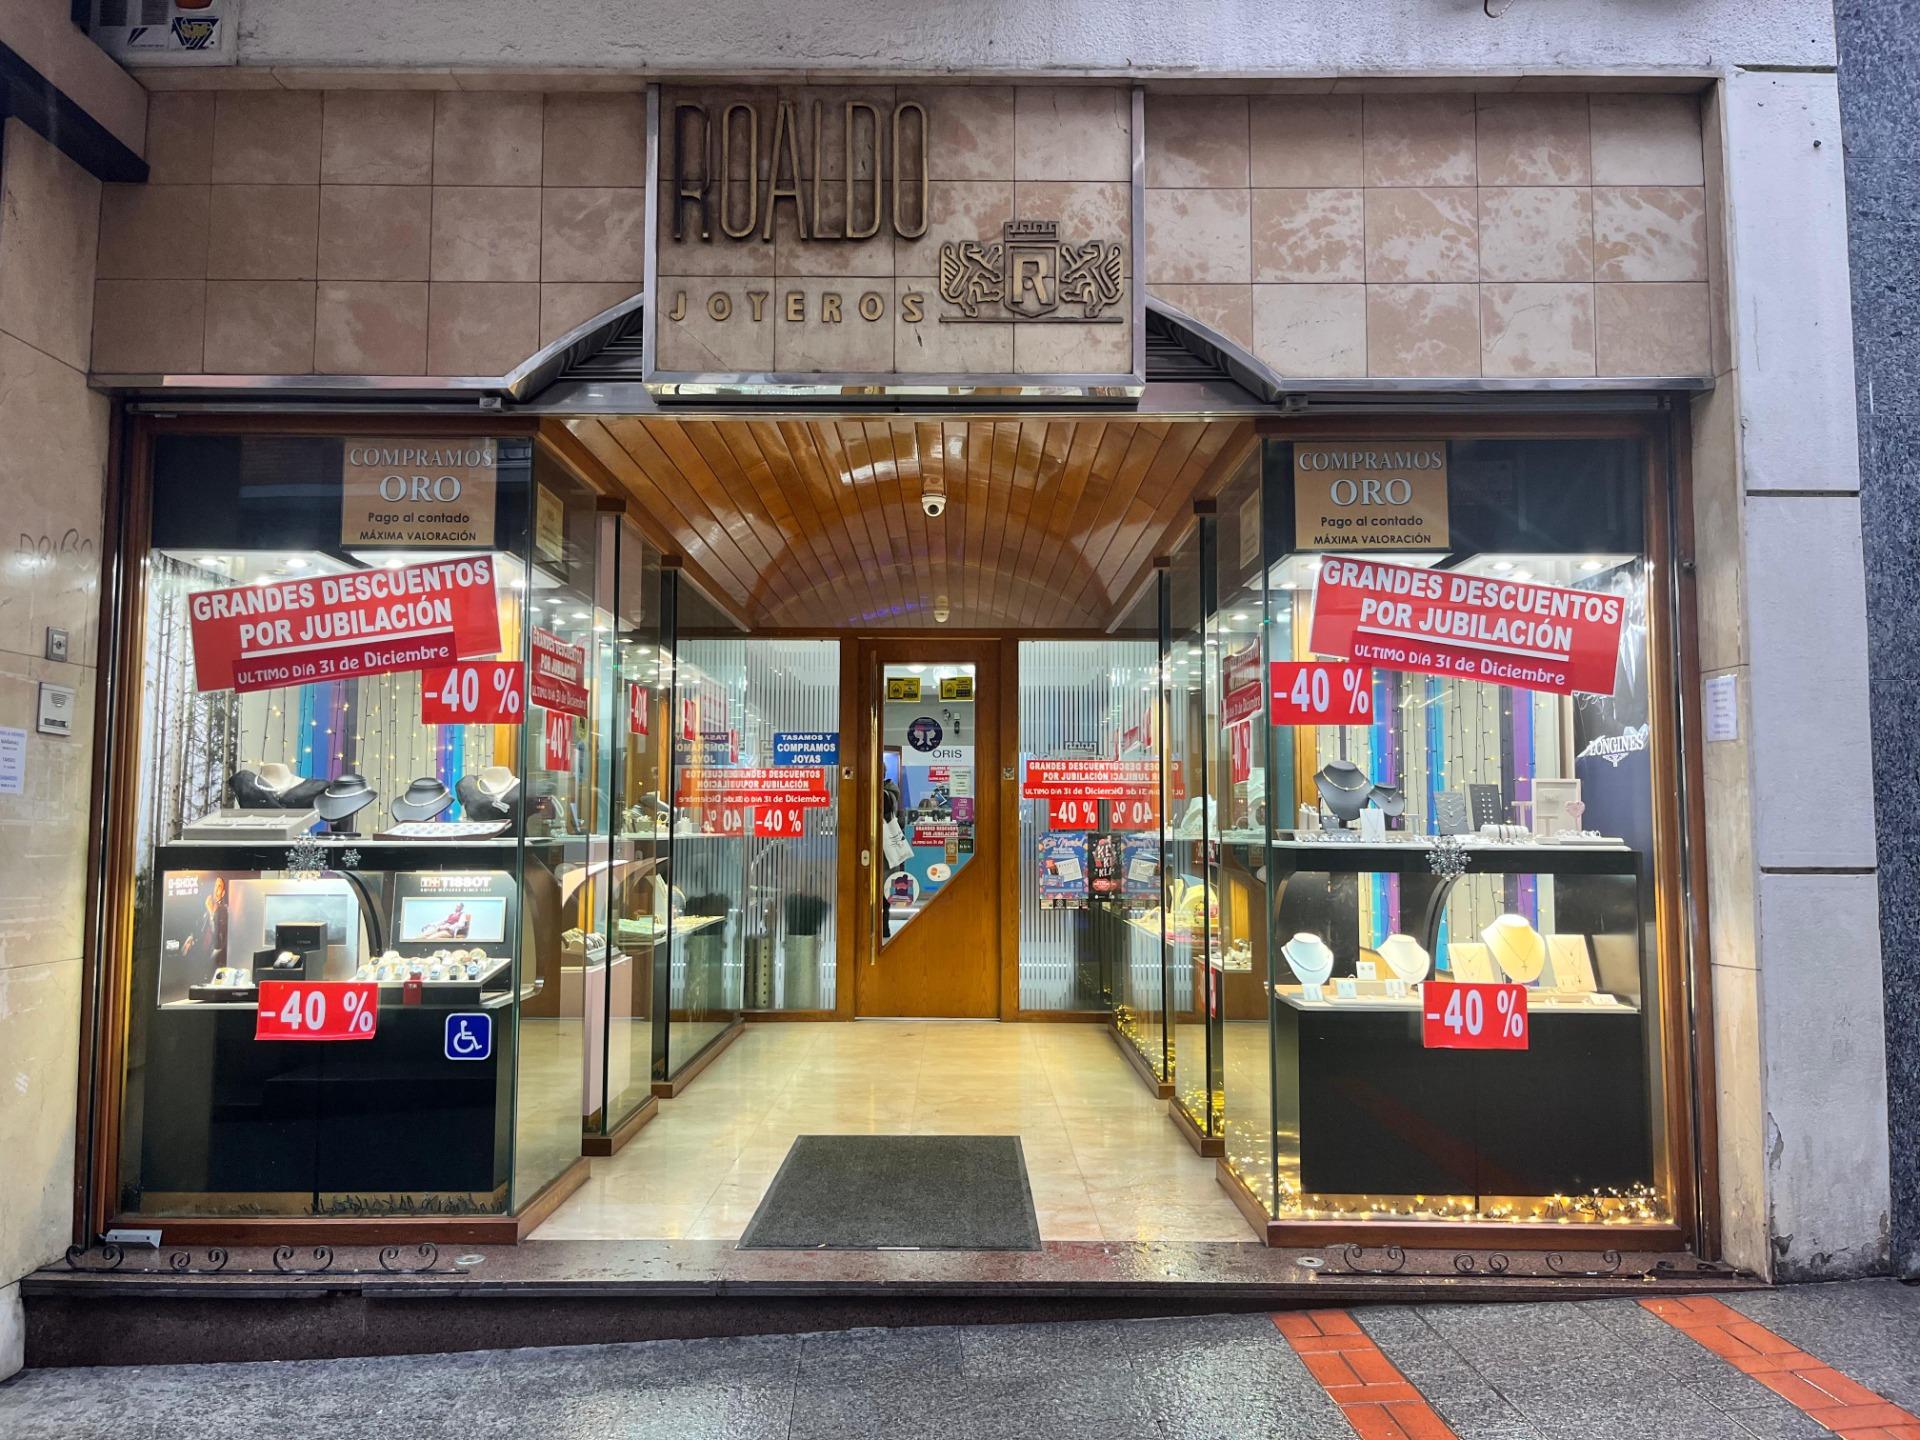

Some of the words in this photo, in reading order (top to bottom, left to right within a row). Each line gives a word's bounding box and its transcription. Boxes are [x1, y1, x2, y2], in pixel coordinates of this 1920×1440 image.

[674, 100, 929, 240] ROALDO
[1011, 253, 1048, 305] R
[670, 291, 925, 322] JOYEROS
[350, 448, 493, 467] COMPRAMOS
[1299, 451, 1443, 471] COMPRAMOS
[379, 475, 461, 502] ORO
[1330, 478, 1412, 506] ORO
[368, 512, 399, 525] Pago
[403, 512, 414, 523] al
[417, 512, 470, 523] contado
[1321, 516, 1353, 529] Pago
[1356, 516, 1367, 526] al
[1371, 515, 1423, 526] contado
[360, 529, 403, 541] MÁXIMA
[406, 529, 476, 541] VALORACIÓN
[1314, 533, 1358, 544] MÁXIMA
[1361, 533, 1431, 544] VALORACIÓN
[193, 582, 315, 621] GRANDES
[321, 560, 491, 605] DESCUENTOS
[1322, 560, 1442, 600] GRANDES
[1450, 578, 1620, 625] DESCUENTOS
[239, 619, 294, 649] POR
[300, 595, 453, 641] JUBILACIÓN
[1360, 598, 1413, 628] POR
[1419, 607, 1572, 651] JUBILACIÓN
[237, 667, 289, 684] ULTIMO
[319, 660, 335, 674] 31
[339, 656, 360, 671] de
[364, 646, 450, 668] Diciembre
[1354, 644, 1405, 662] ULTIMO
[1435, 654, 1450, 669] 31
[1454, 657, 1475, 672] de
[1480, 658, 1566, 686] Diciembre
[424, 667, 479, 713] -40
[493, 667, 520, 714] %
[1273, 667, 1329, 713] -40
[1343, 667, 1369, 714] %
[776, 743, 836, 752] COMPRAMOS
[932, 750, 962, 758] ORIS
[791, 754, 821, 764] JOYAS
[1029, 762, 1066, 770] GRANDES
[761, 778, 809, 788] JUBILACIÓN
[769, 769, 821, 778] DESCUENTOS
[1043, 772, 1059, 780] POR
[1061, 771, 1108, 780] JUBILACIÓN
[773, 794, 783, 803] de
[785, 794, 826, 803] Diciembre
[1073, 787, 1083, 795] de
[756, 809, 783, 832] -40
[788, 809, 801, 832] %
[1050, 801, 1077, 823] -40
[1083, 801, 1096, 823] %
[441, 876, 492, 888] TISSOT
[260, 990, 326, 1030] -40
[343, 990, 373, 1032] %
[1426, 988, 1484, 1037] -40
[1497, 989, 1524, 1038] %
